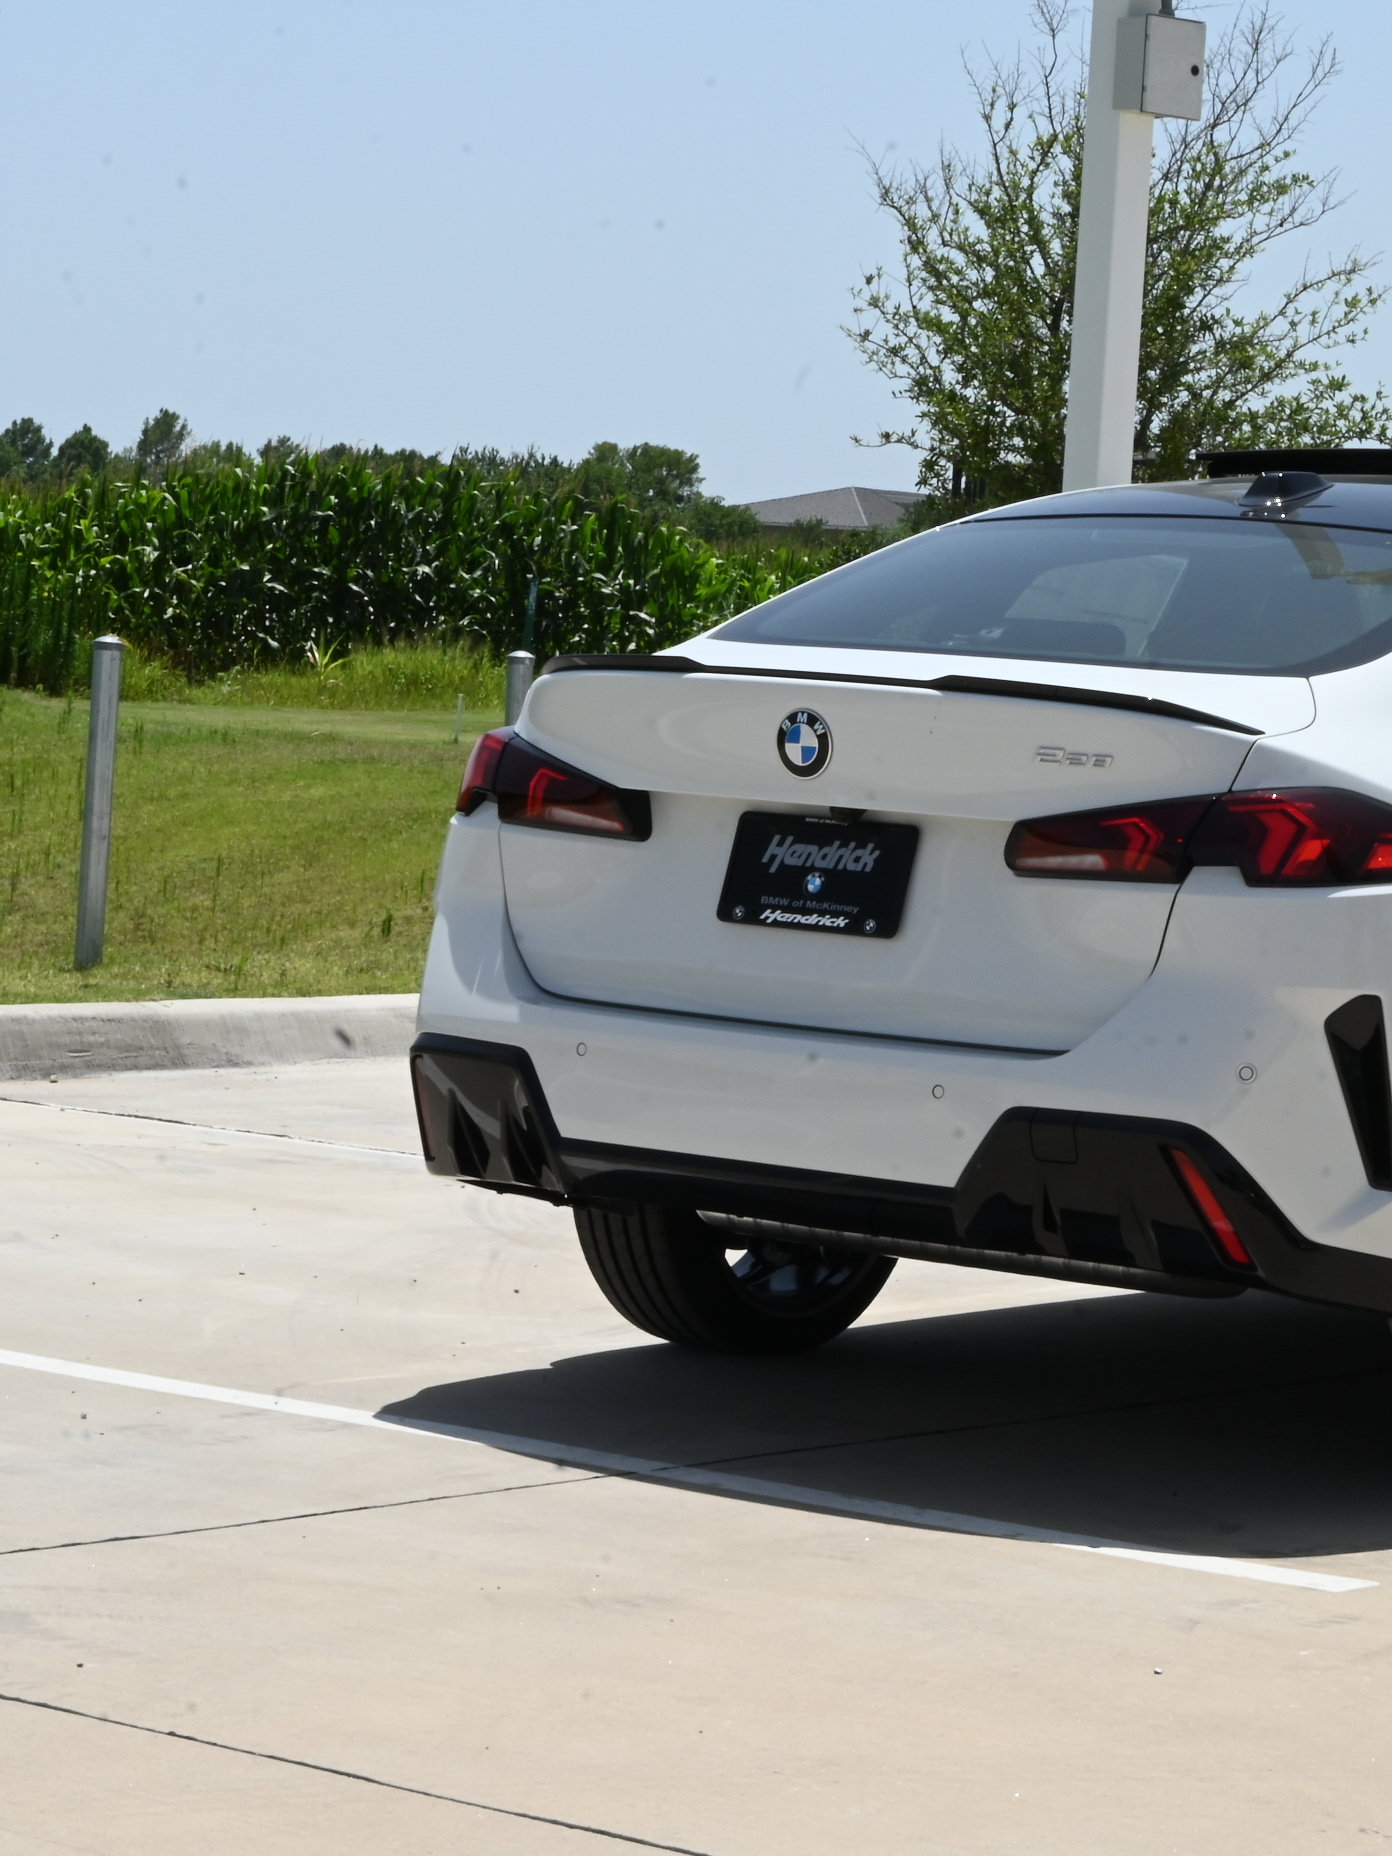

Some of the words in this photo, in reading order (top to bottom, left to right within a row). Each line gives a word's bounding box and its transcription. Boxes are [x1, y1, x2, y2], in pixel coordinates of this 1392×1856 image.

[781, 712, 825, 735] BMW
[761, 834, 880, 873] Hendrick
[760, 895, 790, 906] BMW
[792, 900, 804, 908] of
[806, 900, 860, 915] McKinney
[759, 908, 849, 928] Hendrick
